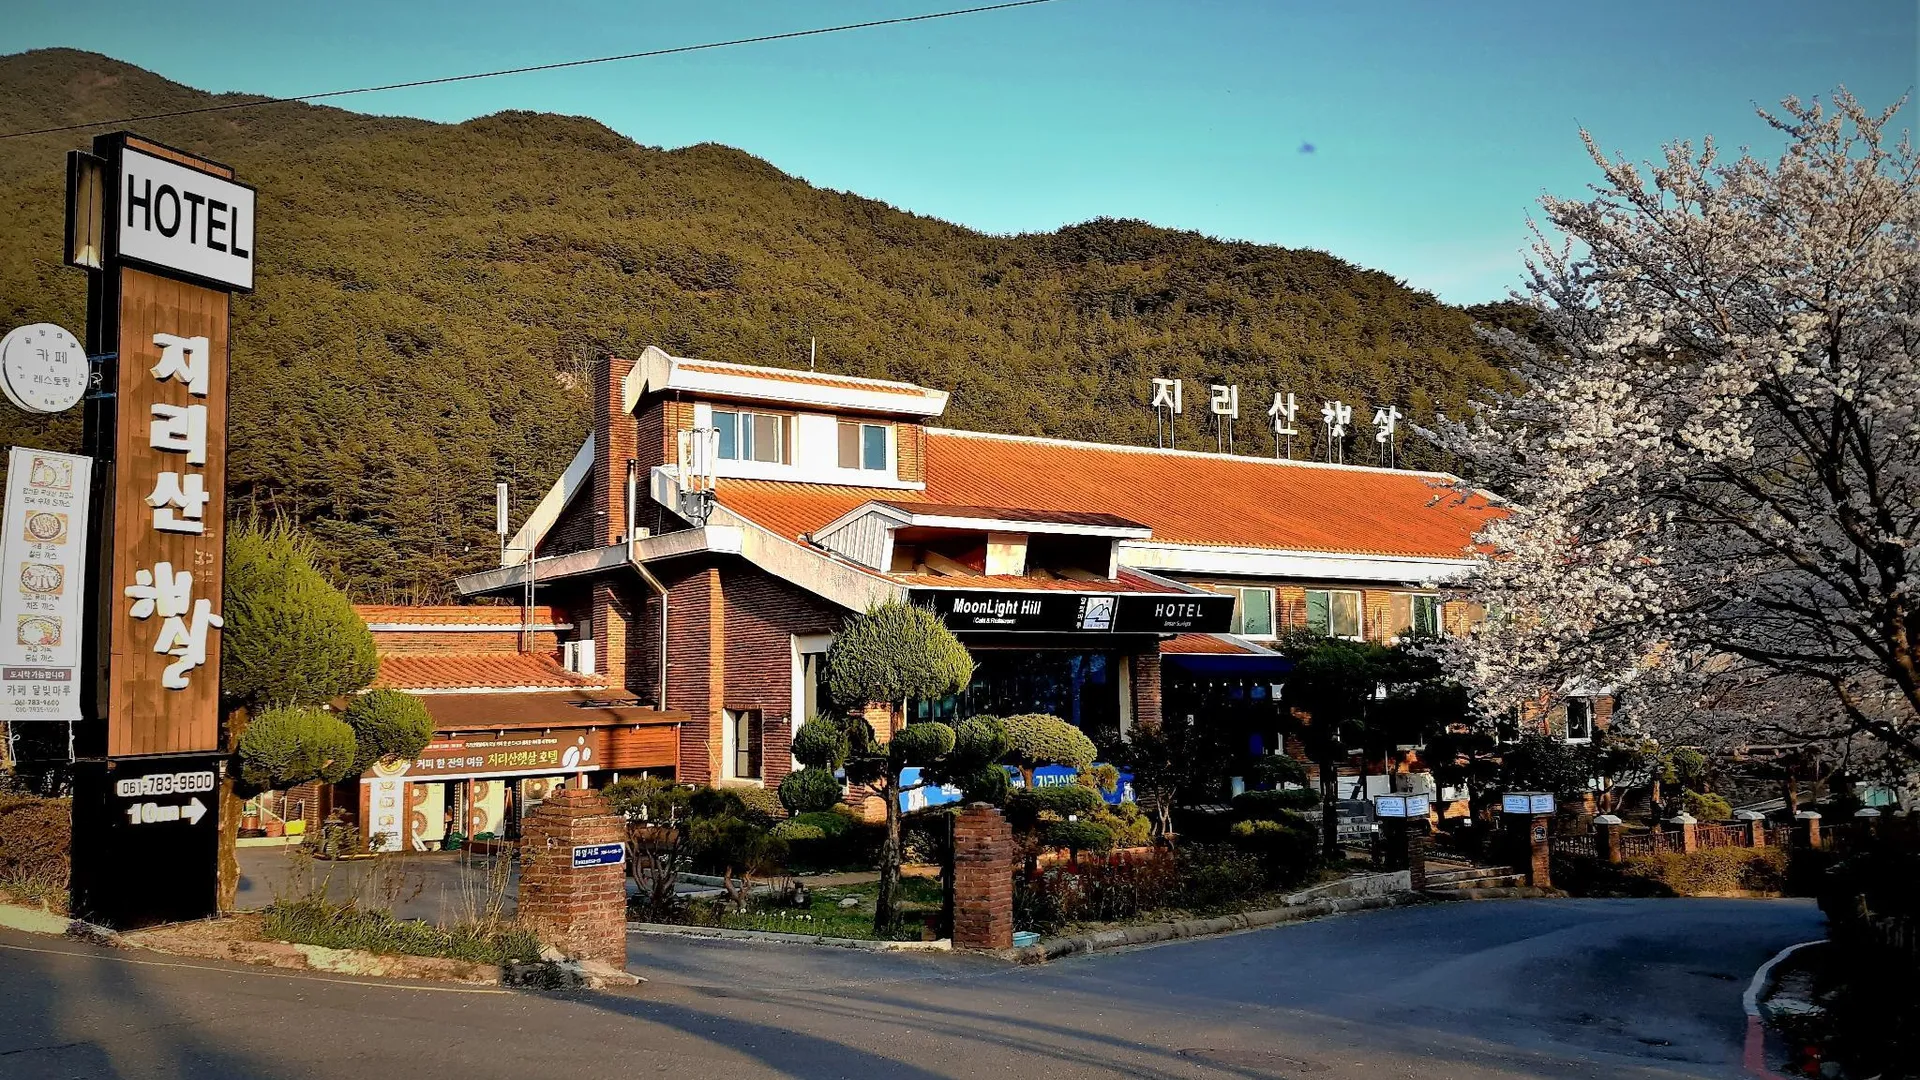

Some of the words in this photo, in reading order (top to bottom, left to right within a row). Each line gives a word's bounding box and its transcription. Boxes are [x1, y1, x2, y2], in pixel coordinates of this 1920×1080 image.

[127, 174, 249, 259] HOTEL
[36, 348, 68, 364] 카페
[33, 374, 71, 388] 레스토랑
[26, 602, 39, 610] 치즈
[953, 598, 1018, 617] MoonLight
[1020, 599, 1042, 615] Hill
[1154, 603, 1203, 617] HOTEL
[7, 684, 27, 696] 카페
[32, 684, 71, 697] 달빛마루
[416, 759, 434, 770] 커피
[436, 758, 445, 769] 한
[447, 757, 464, 769] 잔의
[466, 756, 484, 768] 여유
[487, 750, 538, 767] 지리산햇살
[538, 749, 559, 765] 호텔
[122, 774, 212, 795] 061-783-9600
